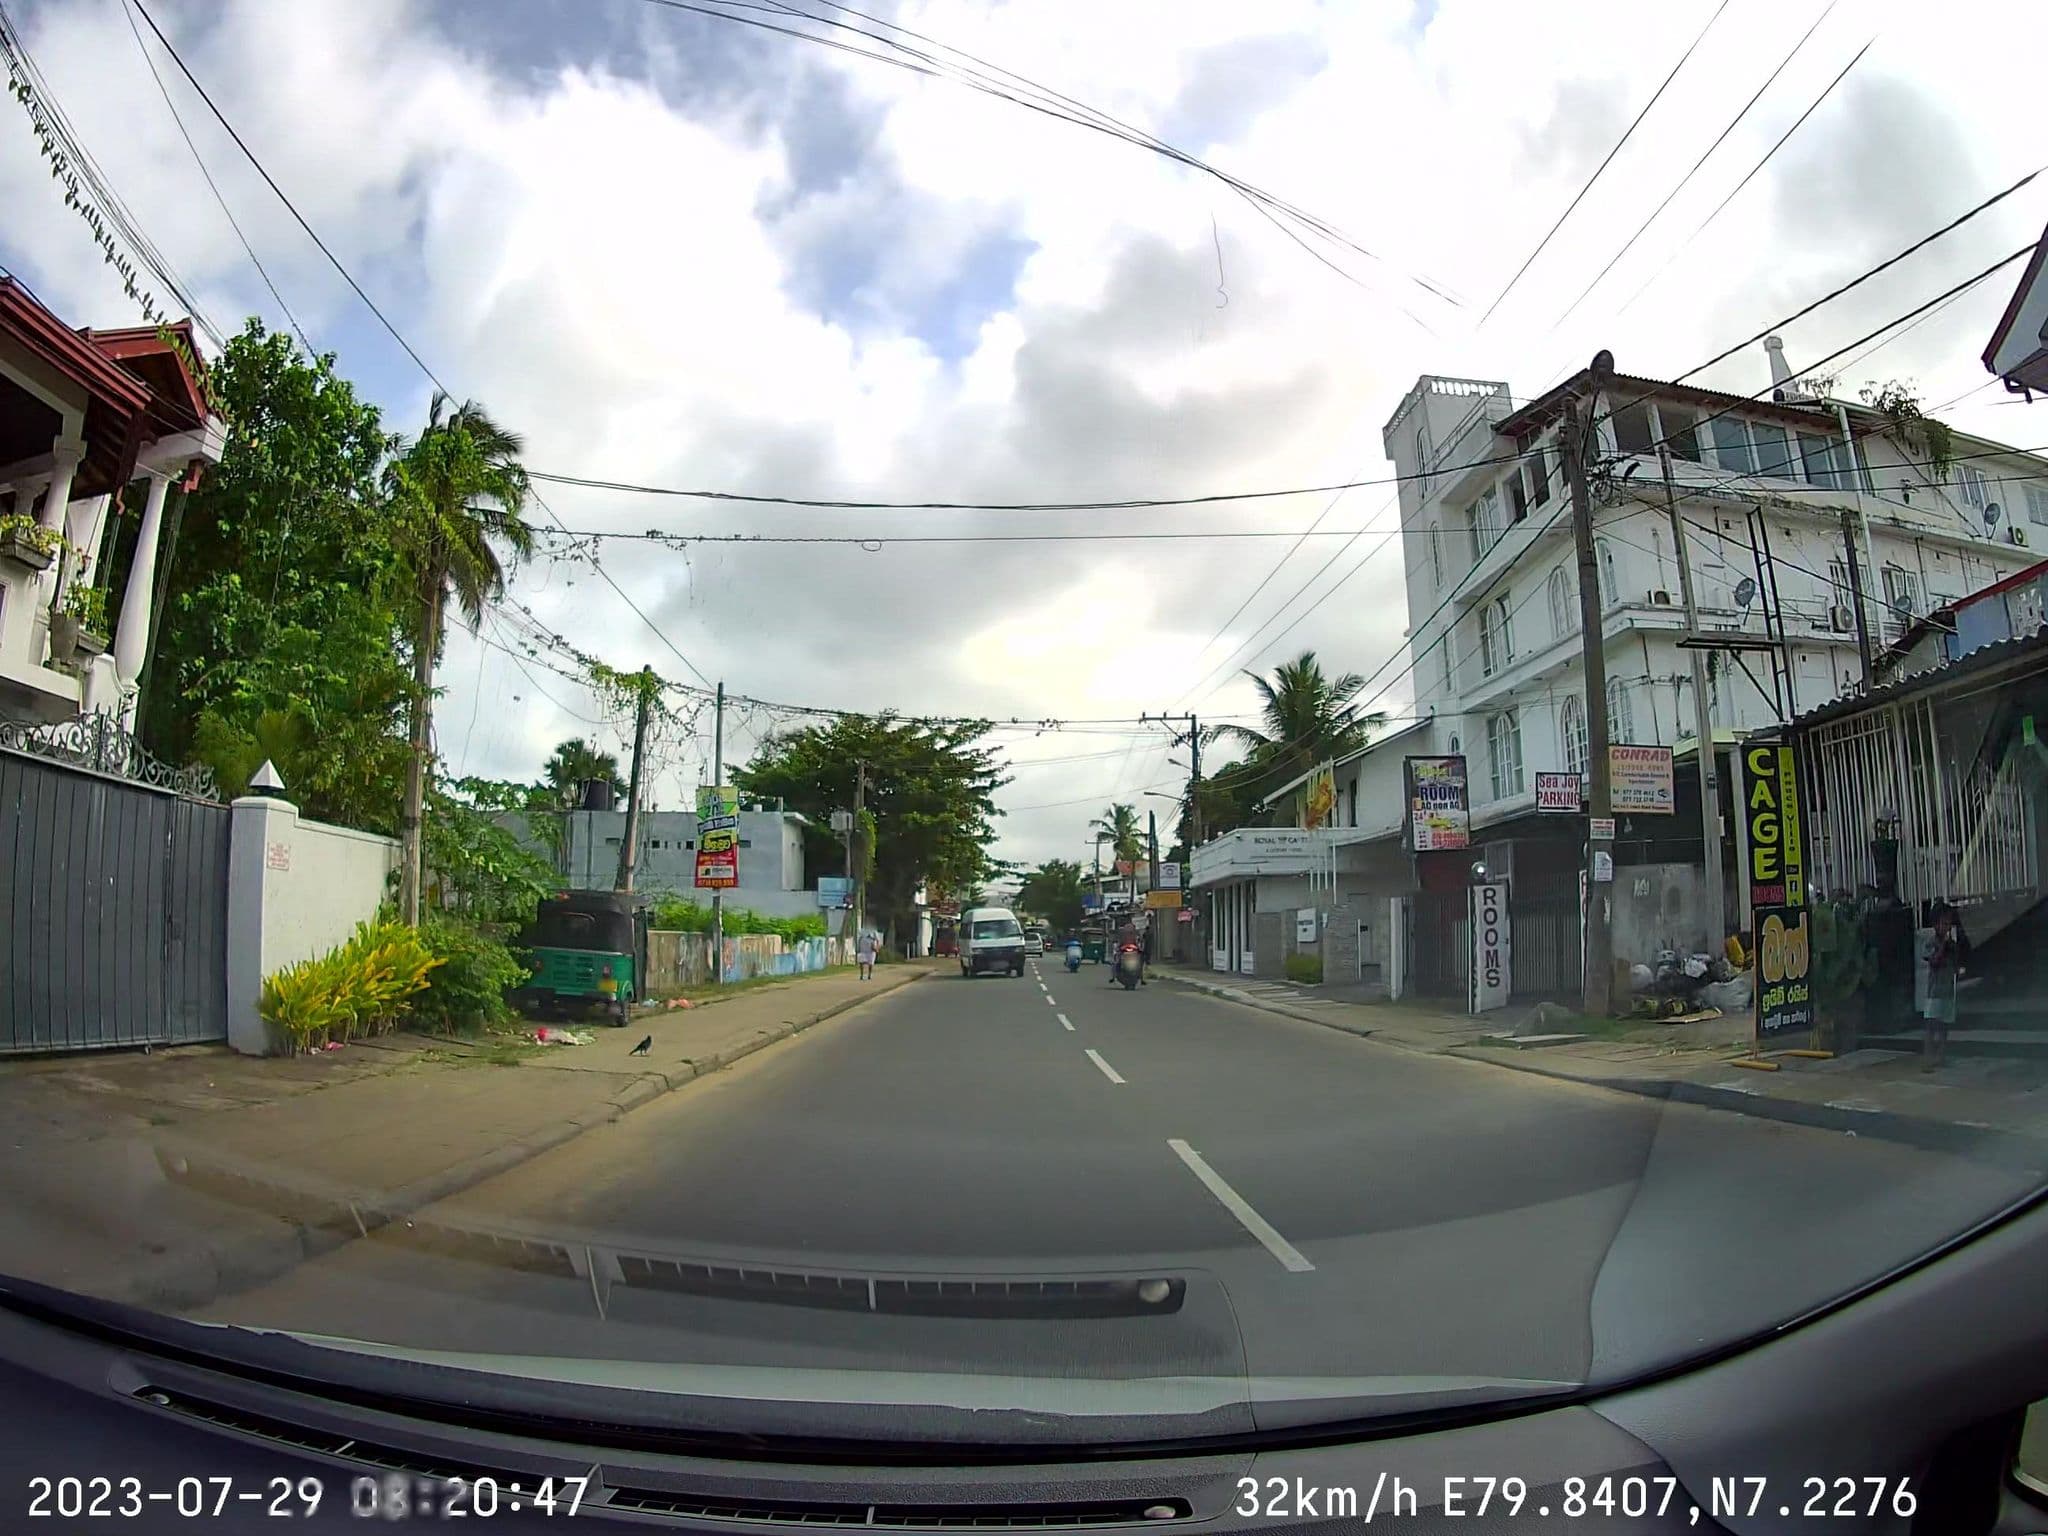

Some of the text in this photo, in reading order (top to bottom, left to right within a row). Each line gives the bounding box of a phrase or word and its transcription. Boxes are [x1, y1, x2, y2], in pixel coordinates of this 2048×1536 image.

[1611, 748, 1670, 762] CONRAD
[1539, 774, 1579, 790] Sea Joy
[1537, 791, 1581, 806] PARKING
[1747, 747, 1779, 880] CAGE
[1483, 887, 1501, 988] ROOMS
